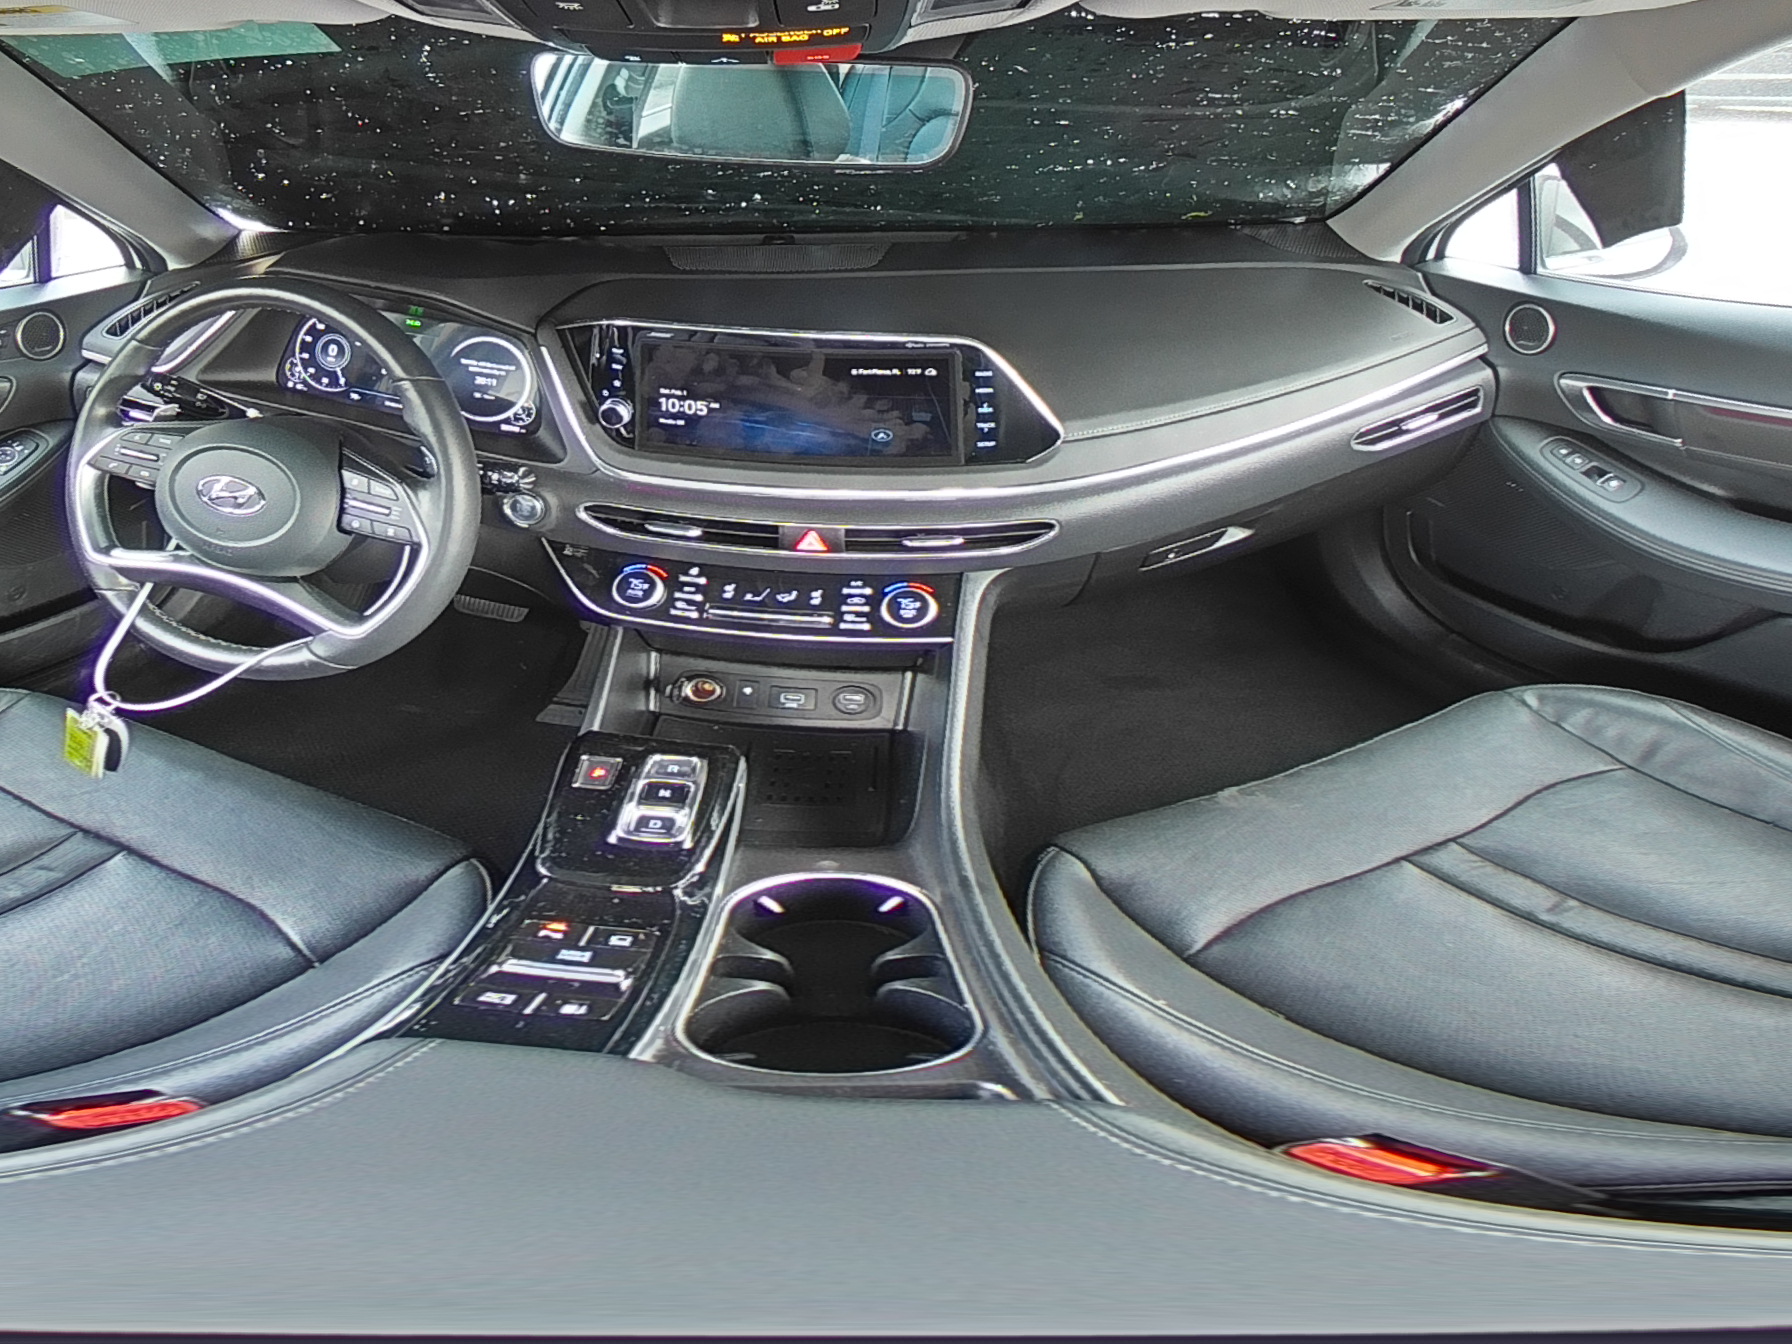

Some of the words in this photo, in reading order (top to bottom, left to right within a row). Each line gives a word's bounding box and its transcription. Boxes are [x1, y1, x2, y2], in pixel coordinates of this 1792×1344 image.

[823, 27, 850, 36] OFF
[658, 397, 709, 416] 10:05
[667, 764, 680, 773] R
[649, 819, 663, 829] D
